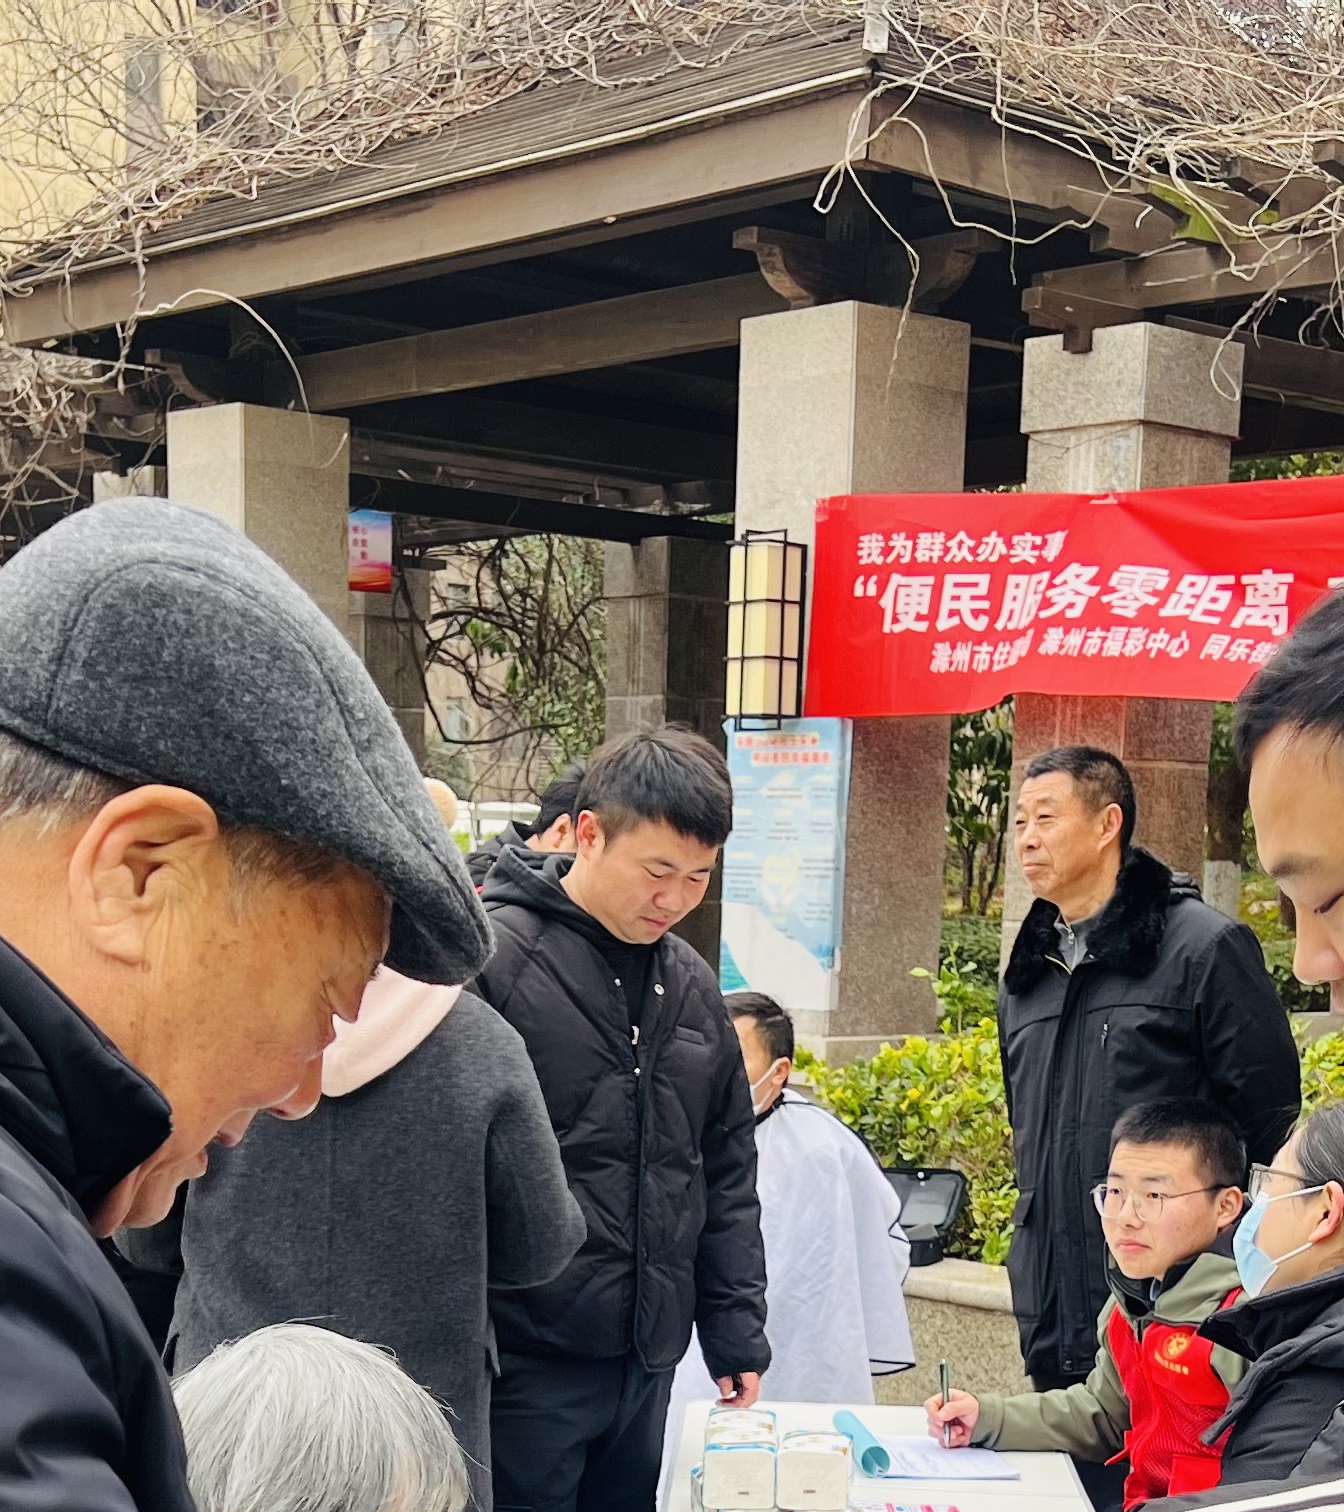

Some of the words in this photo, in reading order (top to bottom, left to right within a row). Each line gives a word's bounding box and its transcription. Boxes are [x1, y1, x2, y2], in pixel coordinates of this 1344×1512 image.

[1037, 625, 1190, 658] 滁州市福彩中心
